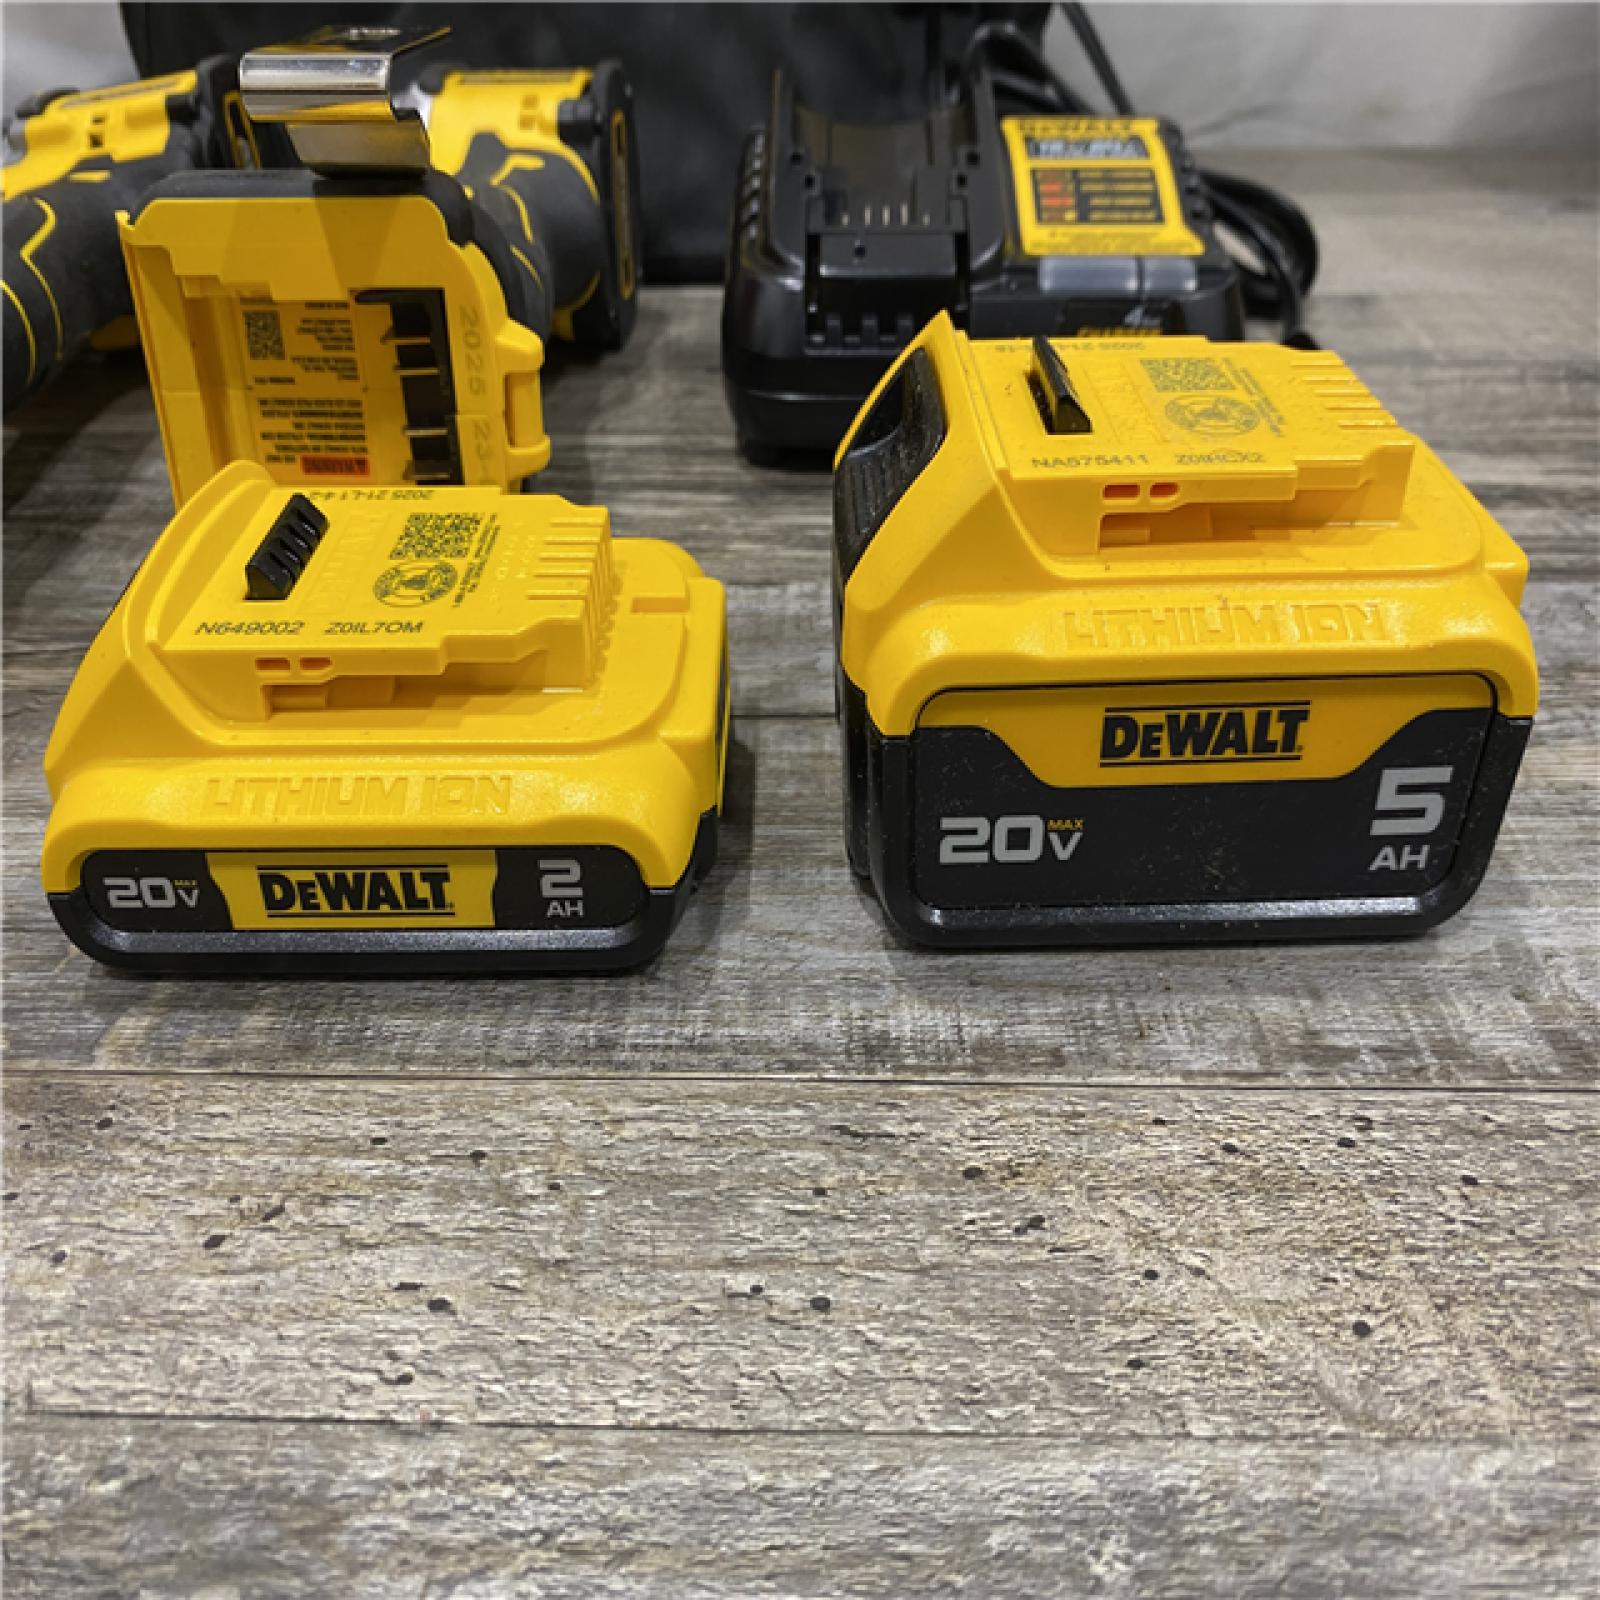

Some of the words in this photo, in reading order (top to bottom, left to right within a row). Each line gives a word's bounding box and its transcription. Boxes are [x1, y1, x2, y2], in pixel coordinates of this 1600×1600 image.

[1063, 603, 1283, 649] LITHIUM
[1291, 601, 1389, 645] ION
[205, 776, 412, 819] LITHIUM
[418, 774, 513, 815] ION
[1370, 766, 1453, 836] 5
[1368, 844, 1430, 871] AH
[537, 859, 584, 899] 2
[546, 901, 585, 918] AH
